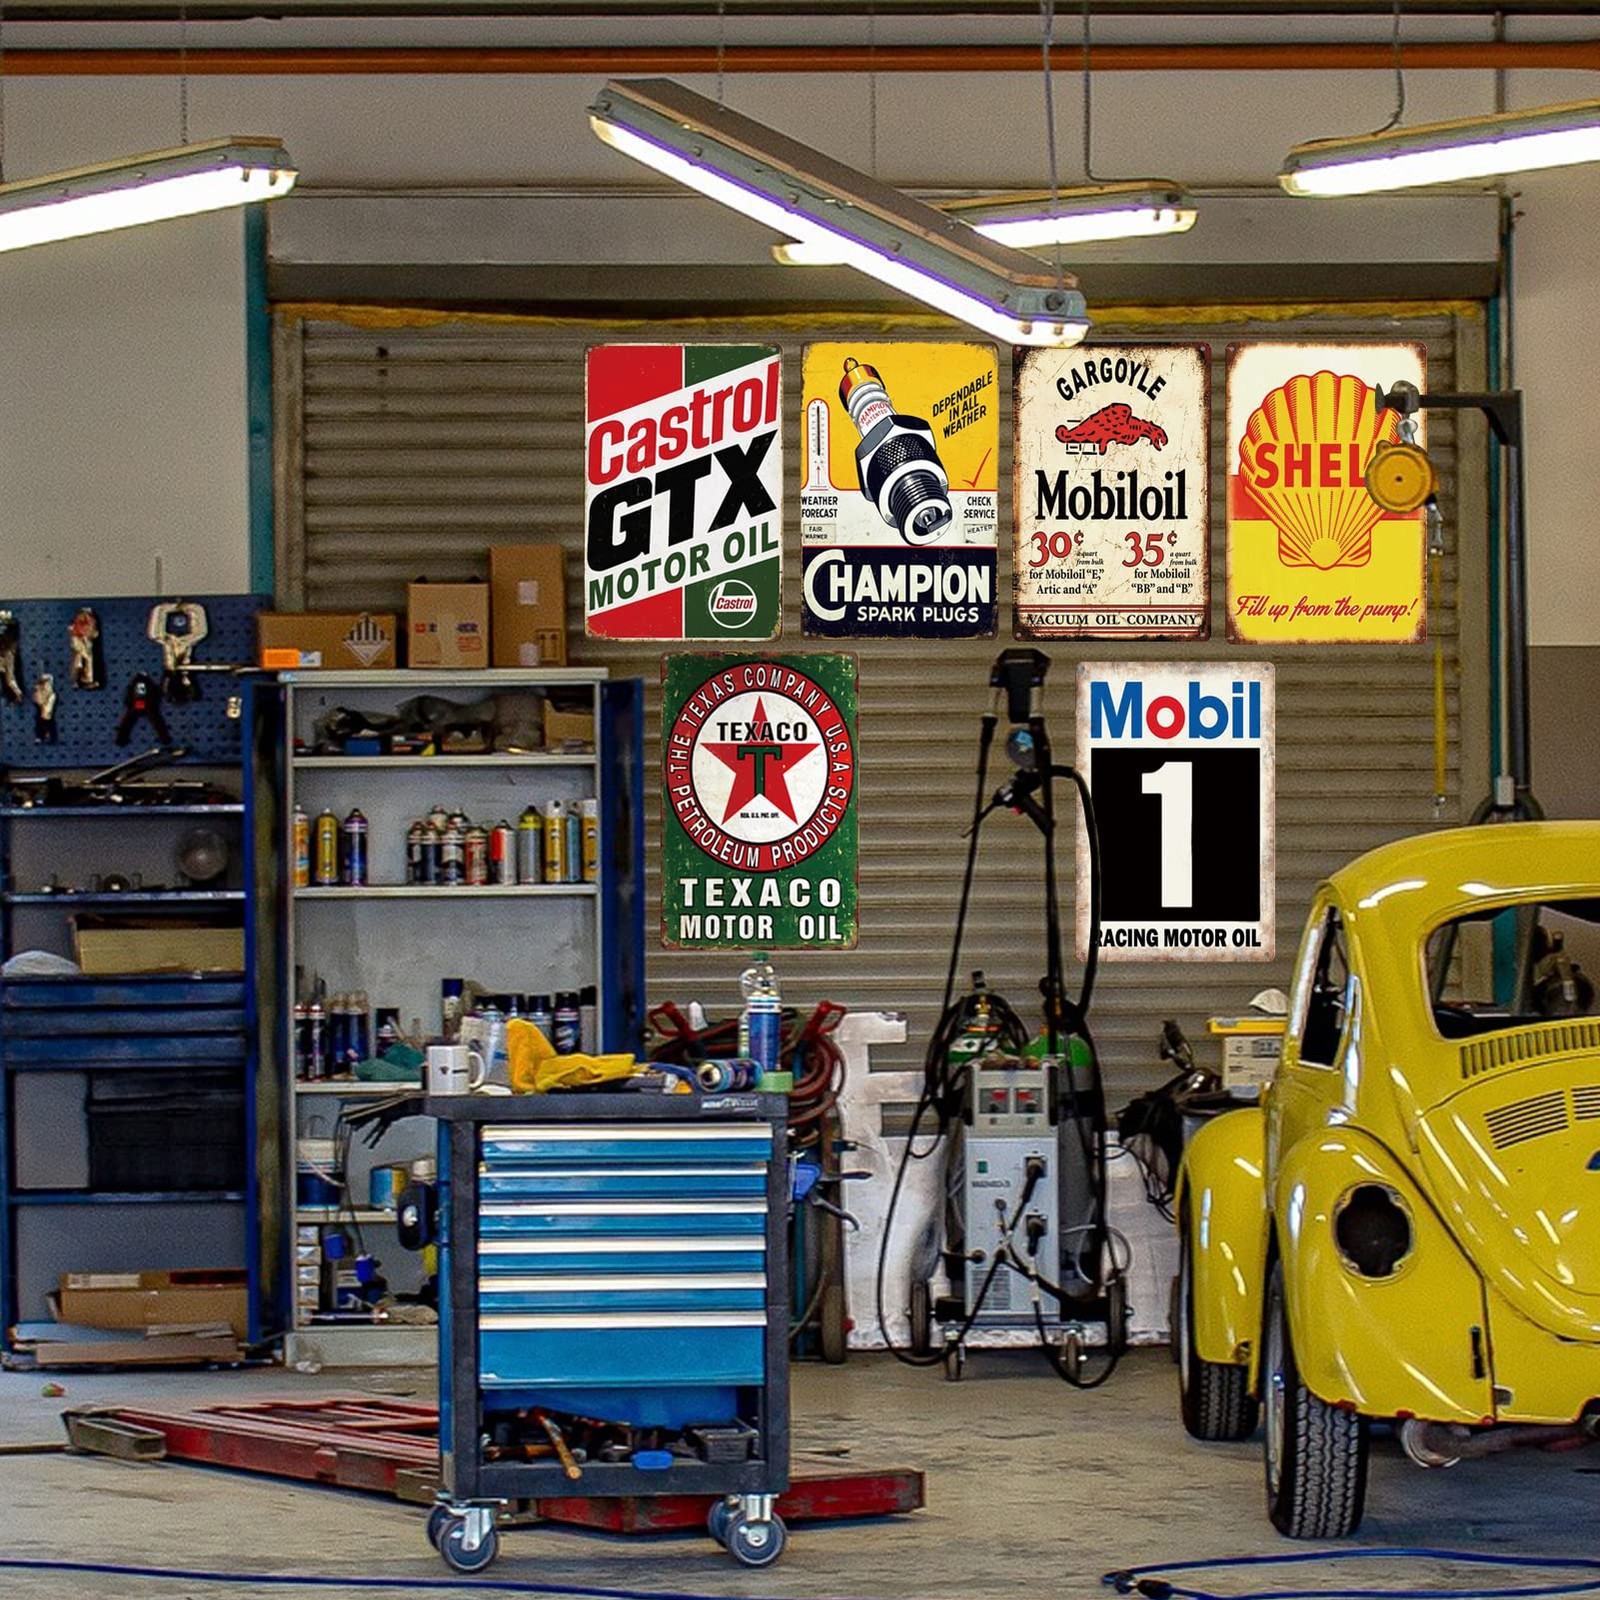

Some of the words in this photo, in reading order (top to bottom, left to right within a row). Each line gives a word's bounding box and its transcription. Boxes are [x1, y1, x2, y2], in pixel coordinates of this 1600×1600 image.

[1056, 357, 1167, 401] GARGOYLE
[932, 370, 993, 418] DEPENDABLE
[949, 405, 960, 422] IN
[961, 395, 979, 415] ALL
[588, 360, 780, 485] Castrol
[943, 405, 987, 439] WEATHER
[1254, 442, 1366, 489] SHEL
[587, 429, 778, 572] GTX
[801, 496, 838, 506] WEATHER
[967, 496, 992, 506] CHECK
[1035, 469, 1188, 520] Mobiloil
[801, 508, 838, 519] FORECAST
[964, 509, 996, 519] SERVICE
[967, 524, 993, 534] HEATER
[589, 539, 710, 611] MOTOR
[723, 521, 779, 565] OIL
[1169, 559, 1184, 567] from
[1175, 551, 1191, 559] quart
[803, 550, 990, 622] CHAMPION
[1029, 568, 1043, 580] for
[1045, 568, 1085, 580] Mobiloil
[1134, 568, 1148, 579] for
[1150, 568, 1190, 579] Mobiloil
[1036, 584, 1061, 594] Artic
[1063, 584, 1081, 594] and
[1156, 583, 1175, 594] and
[716, 597, 754, 610] Castrol
[857, 606, 916, 622] SPARK
[922, 606, 980, 622] PLUGS
[1236, 596, 1270, 617] Fill
[1267, 603, 1290, 623] up
[1288, 596, 1332, 622] from
[1333, 596, 1361, 616] the
[1357, 598, 1418, 623] pump!
[1029, 614, 1089, 625] VACUUM
[1095, 614, 1120, 625] OIL
[1126, 614, 1198, 625] COMPANY
[670, 734, 691, 773] THE
[681, 674, 735, 727] TEXAS
[743, 667, 831, 718] COMPANY
[1090, 681, 1261, 740] Mobil
[716, 722, 808, 742] TEXACO
[737, 745, 782, 797] T
[672, 784, 759, 868] PETROLEUM
[771, 784, 848, 867] PRODUCTS
[1142, 761, 1193, 908] 1
[679, 878, 842, 908] TEXACO
[680, 914, 773, 940] MOTOR
[799, 914, 842, 940] OIL
[1164, 928, 1227, 947] MOTOR
[1232, 928, 1261, 947] OIL
